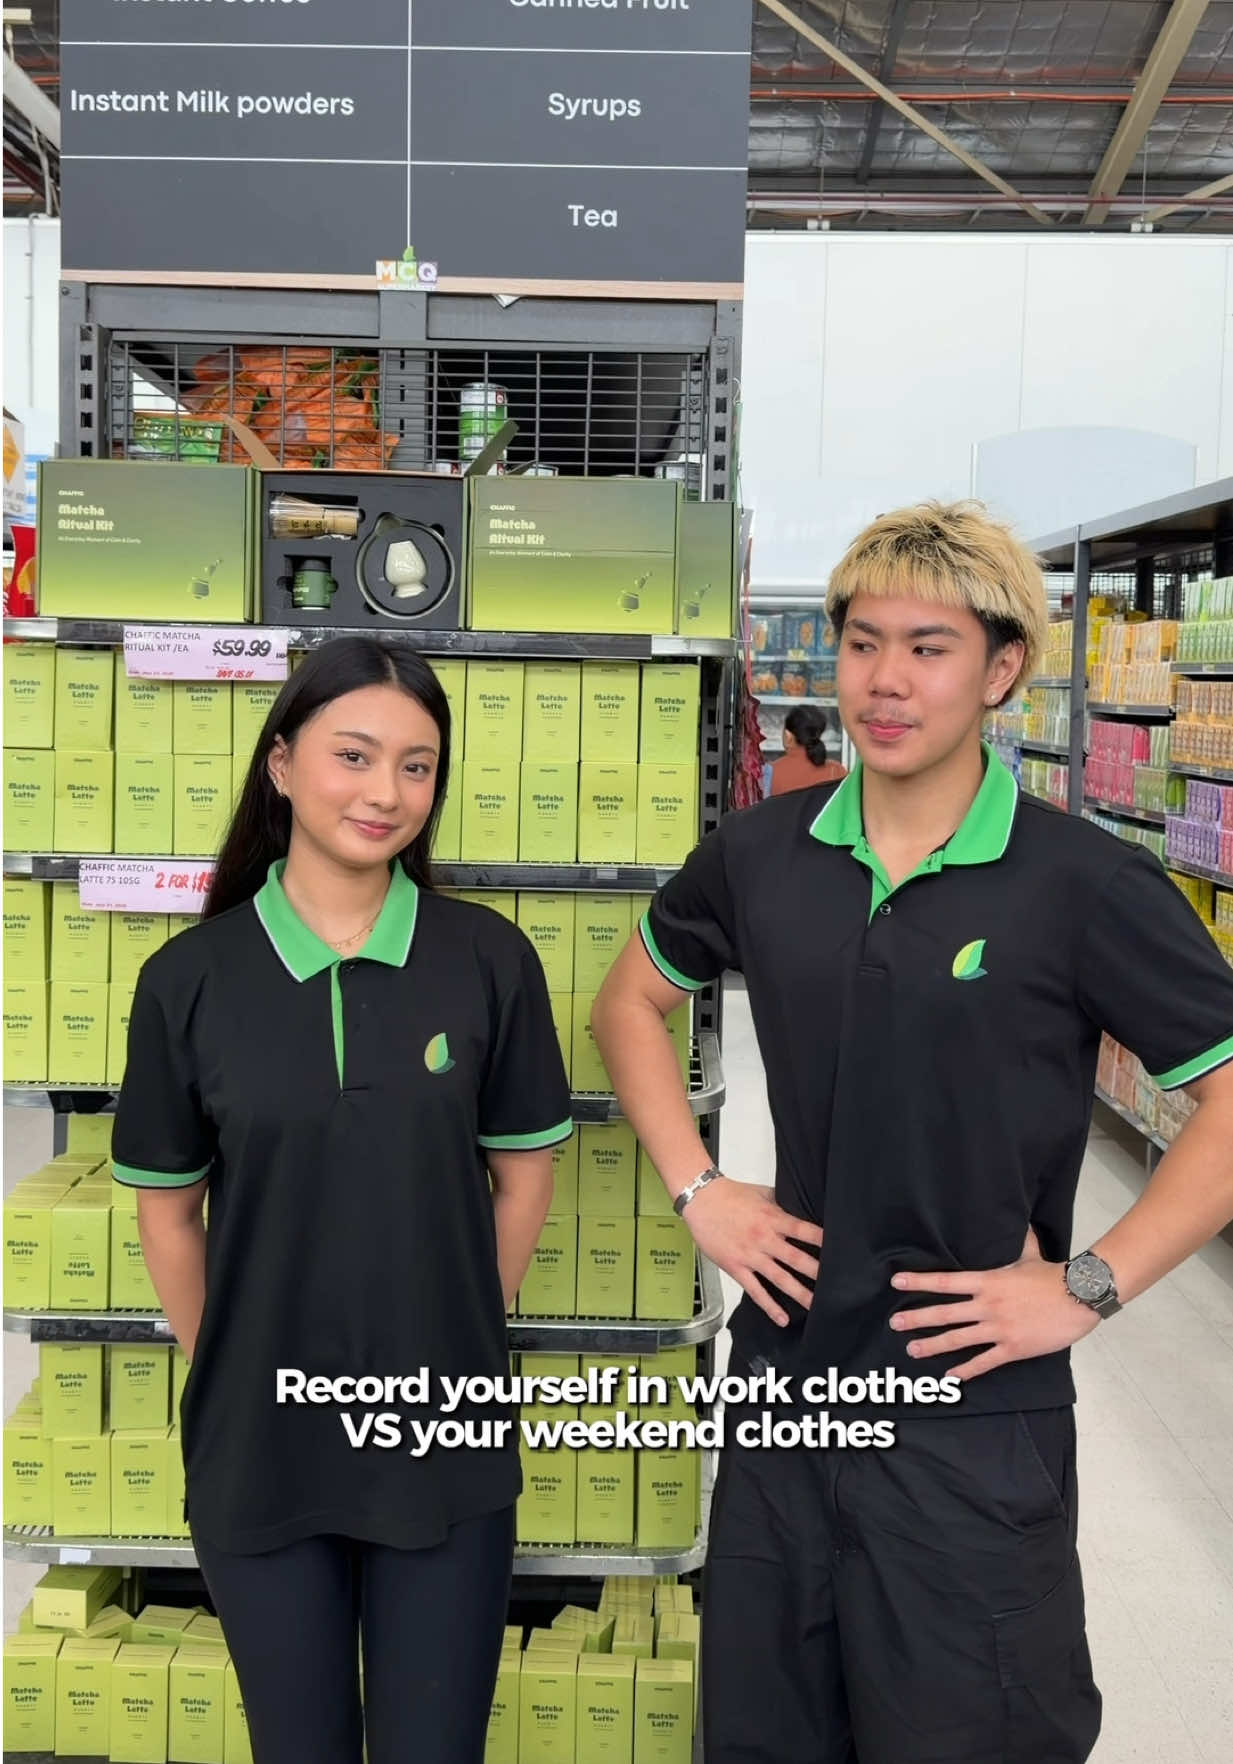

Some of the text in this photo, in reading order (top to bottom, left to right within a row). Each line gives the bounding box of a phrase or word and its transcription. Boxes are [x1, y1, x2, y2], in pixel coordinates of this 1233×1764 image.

[70, 89, 355, 118] Instant Milk powders
[548, 92, 642, 120] Syrups
[568, 204, 618, 228] Tea
[376, 260, 438, 281] MCQ
[58, 504, 105, 516] Matcha
[57, 519, 114, 532] Ritual Kit
[489, 519, 536, 530] Matcha
[488, 533, 546, 545] Ritual Kit
[162, 631, 201, 641] MATCHA
[124, 643, 189, 654] RITUAL KIT /EA
[212, 639, 272, 657] $59.99
[8, 678, 41, 686] Matcha
[67, 682, 100, 690] Matcha
[127, 684, 161, 692] Matcha
[185, 686, 219, 694] Matcha
[244, 688, 278, 696] Matcha
[478, 693, 511, 701] Matcha
[535, 693, 569, 701] Matcha
[593, 693, 626, 701] Matcha
[654, 697, 687, 705] Matcha
[7, 782, 41, 790] Matcha
[66, 783, 100, 791] Matcha
[127, 785, 161, 794] Matcha
[186, 786, 219, 795] Matcha
[474, 793, 507, 801] Matcha
[531, 794, 564, 802] Matcha
[591, 795, 625, 803] Matcha
[651, 796, 683, 804] Matcha
[79, 862, 155, 873] CHAFFIC MATCHA
[79, 875, 103, 885] LATTE
[154, 871, 165, 889] 2
[168, 873, 189, 889] FOR
[63, 915, 97, 923] Matcha
[122, 916, 155, 924] Matcha
[529, 925, 562, 933] Matcha
[586, 925, 619, 933] Matcha
[62, 1014, 95, 1023] Matcha
[591, 1149, 623, 1157] Matcha
[6, 1240, 40, 1248] Matcha
[589, 1248, 622, 1257] Matcha
[649, 1249, 682, 1257] Matcha
[122, 1361, 156, 1369] Matcha
[55, 1372, 88, 1380] Matcha
[11, 1460, 44, 1468] Matcha
[122, 1470, 156, 1478] Matcha
[530, 1476, 563, 1484] Matcha
[588, 1476, 622, 1484] Matcha
[651, 1480, 683, 1488] Matcha
[67, 1690, 101, 1698] Matcha
[179, 1698, 213, 1706] Matcha
[531, 1704, 564, 1712] Matcha
[587, 1706, 621, 1714] Matcha
[646, 1712, 680, 1720] Matcha
